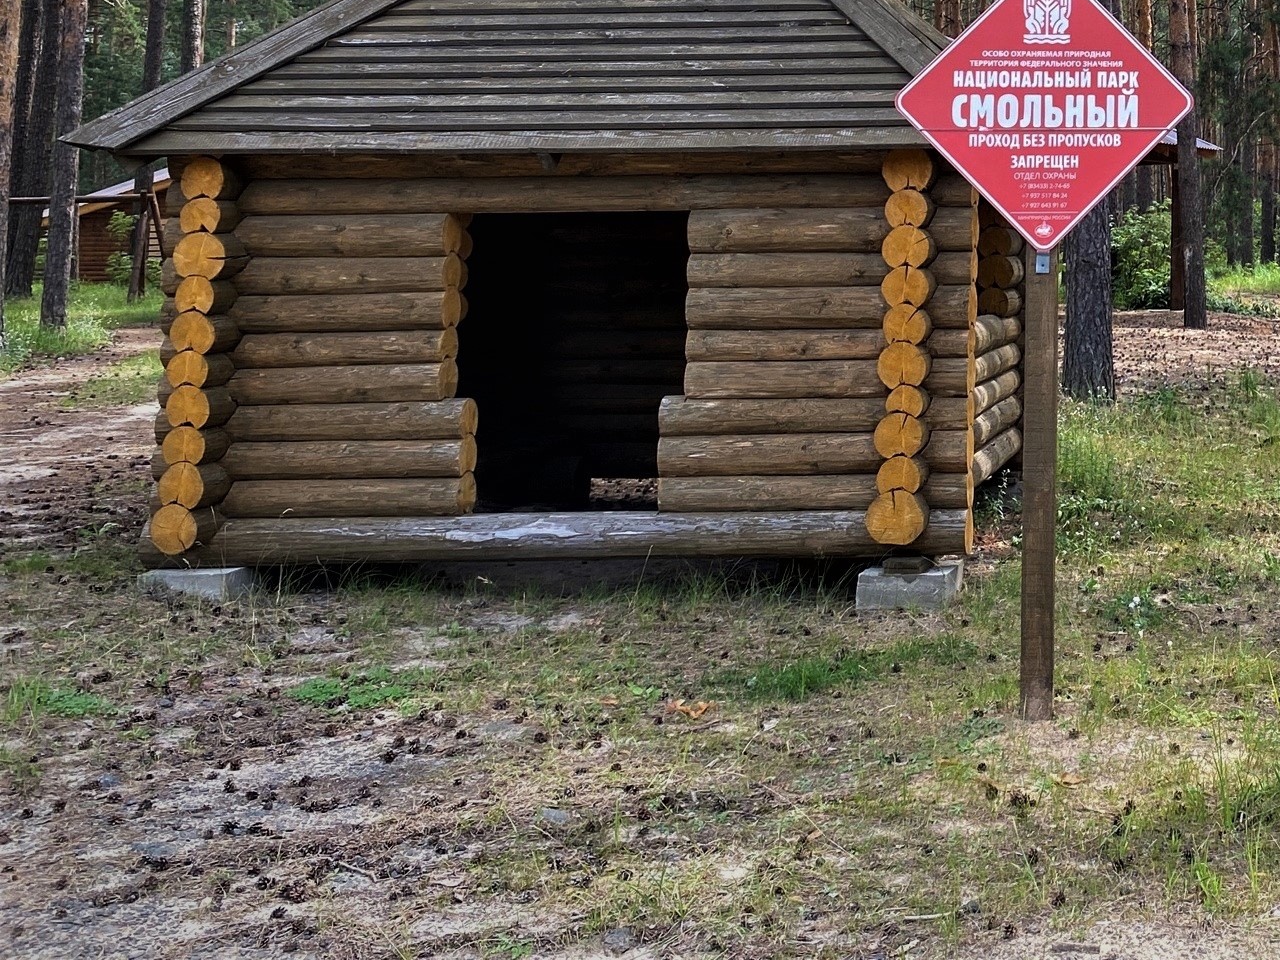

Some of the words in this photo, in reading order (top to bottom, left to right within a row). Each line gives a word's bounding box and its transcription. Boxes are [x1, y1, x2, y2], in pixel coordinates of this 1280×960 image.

[982, 50, 1008, 58] ОСОБО
[1011, 50, 1063, 58] ОХРАНЯЕМАЯ
[1064, 50, 1111, 59] ПРИРОДНАЯ
[1020, 60, 1081, 68] ФЕДЕРАЛЬНОГО
[1083, 60, 1123, 68] ЗНАЧЕНИЯ
[953, 68, 1092, 89] НАЦИОНАЛЬНЫЙ
[1097, 71, 1139, 88] ПАРК
[952, 88, 1139, 128] СМОЛЬНЫЙ
[969, 133, 1020, 149] ПРОХОД
[1023, 133, 1045, 147] БЕЗ
[1048, 133, 1121, 148] ПРОПУСКОВ
[1010, 155, 1079, 170] ЗАПРЕЩЕН
[1014, 172, 1040, 180] ОТДЕЛ
[1042, 172, 1076, 180] ОХРАНЫ
